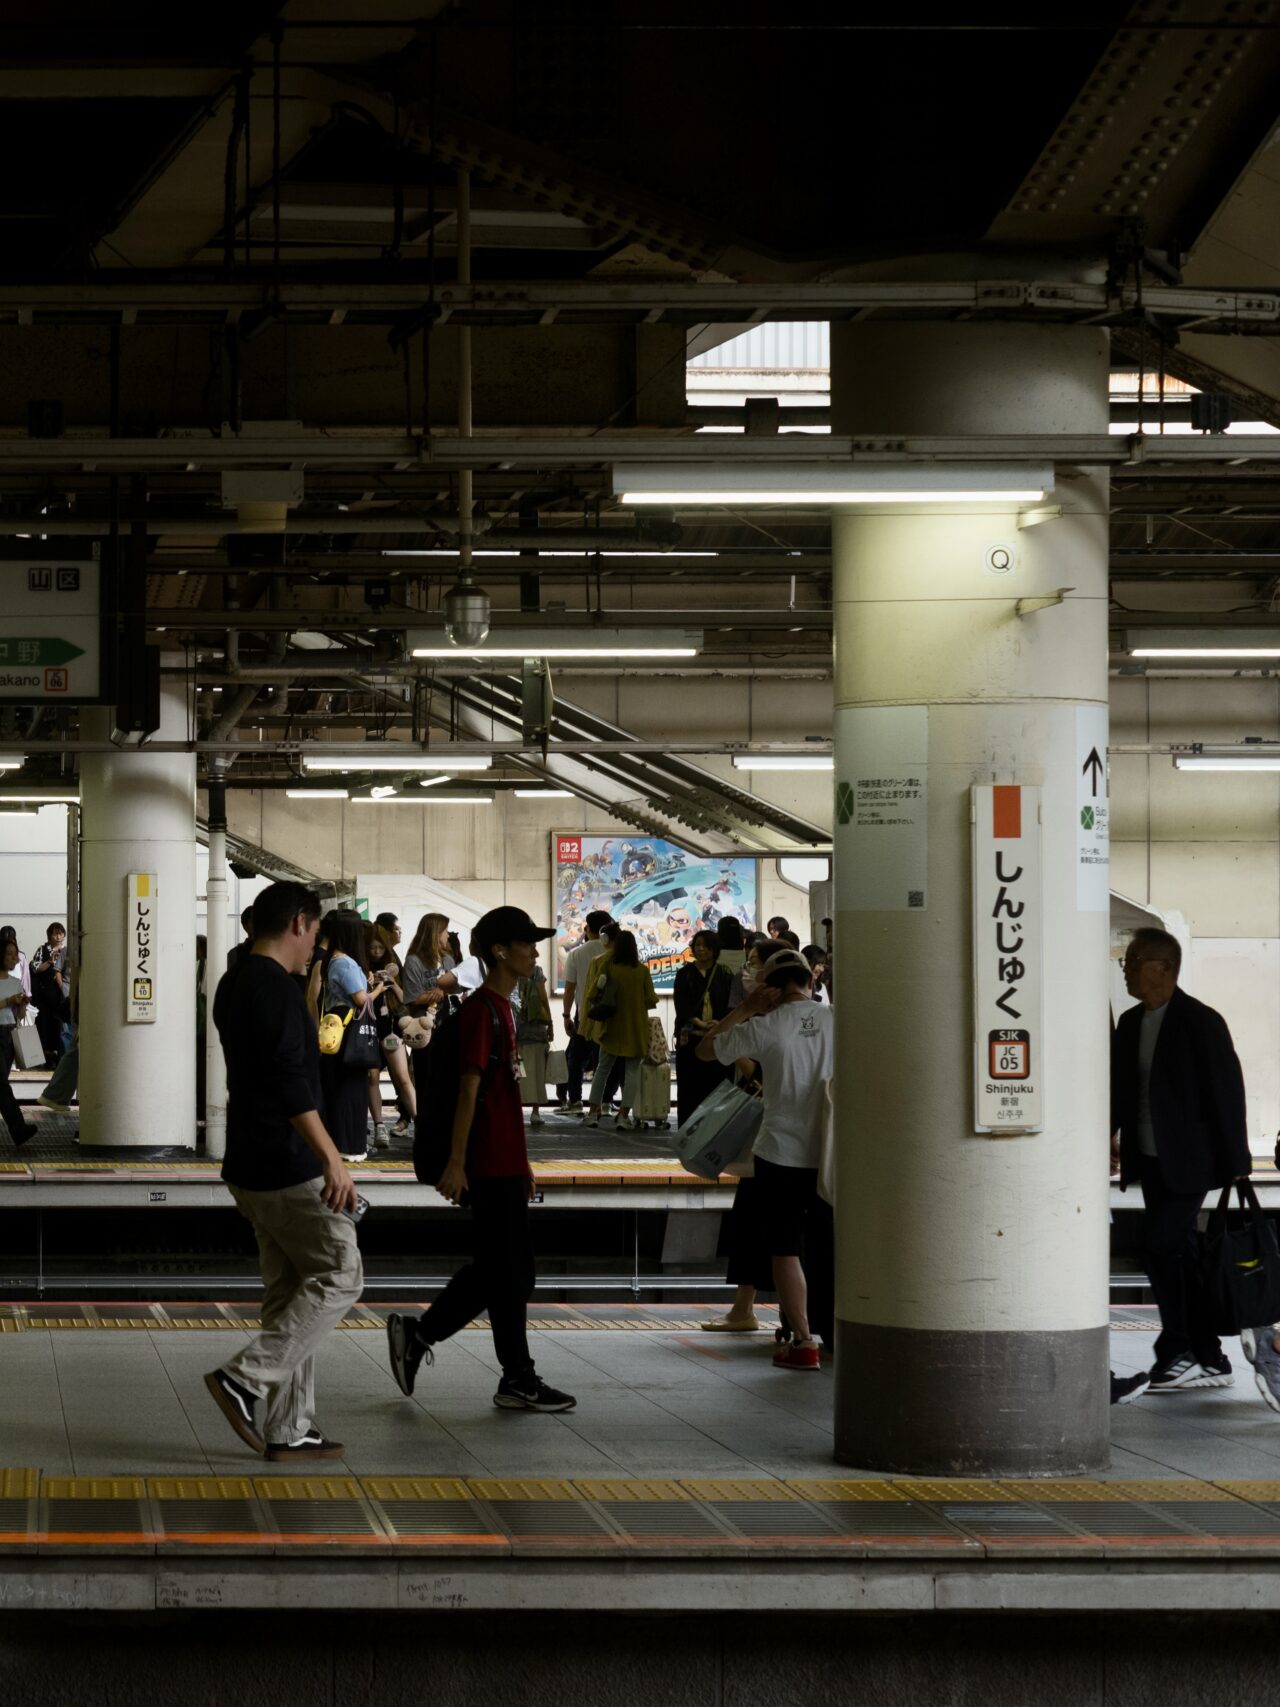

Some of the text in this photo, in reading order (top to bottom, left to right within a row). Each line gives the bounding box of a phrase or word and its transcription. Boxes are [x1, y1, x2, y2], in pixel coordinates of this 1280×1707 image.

[991, 549, 1010, 571] Q
[135, 901, 151, 975] しんじゅく
[991, 851, 1026, 1020] しんじゅく
[998, 1030, 1020, 1041] SJK
[1003, 1046, 1017, 1057] JC
[999, 1056, 1019, 1070] 05
[985, 1083, 1035, 1096] Shinjuku
